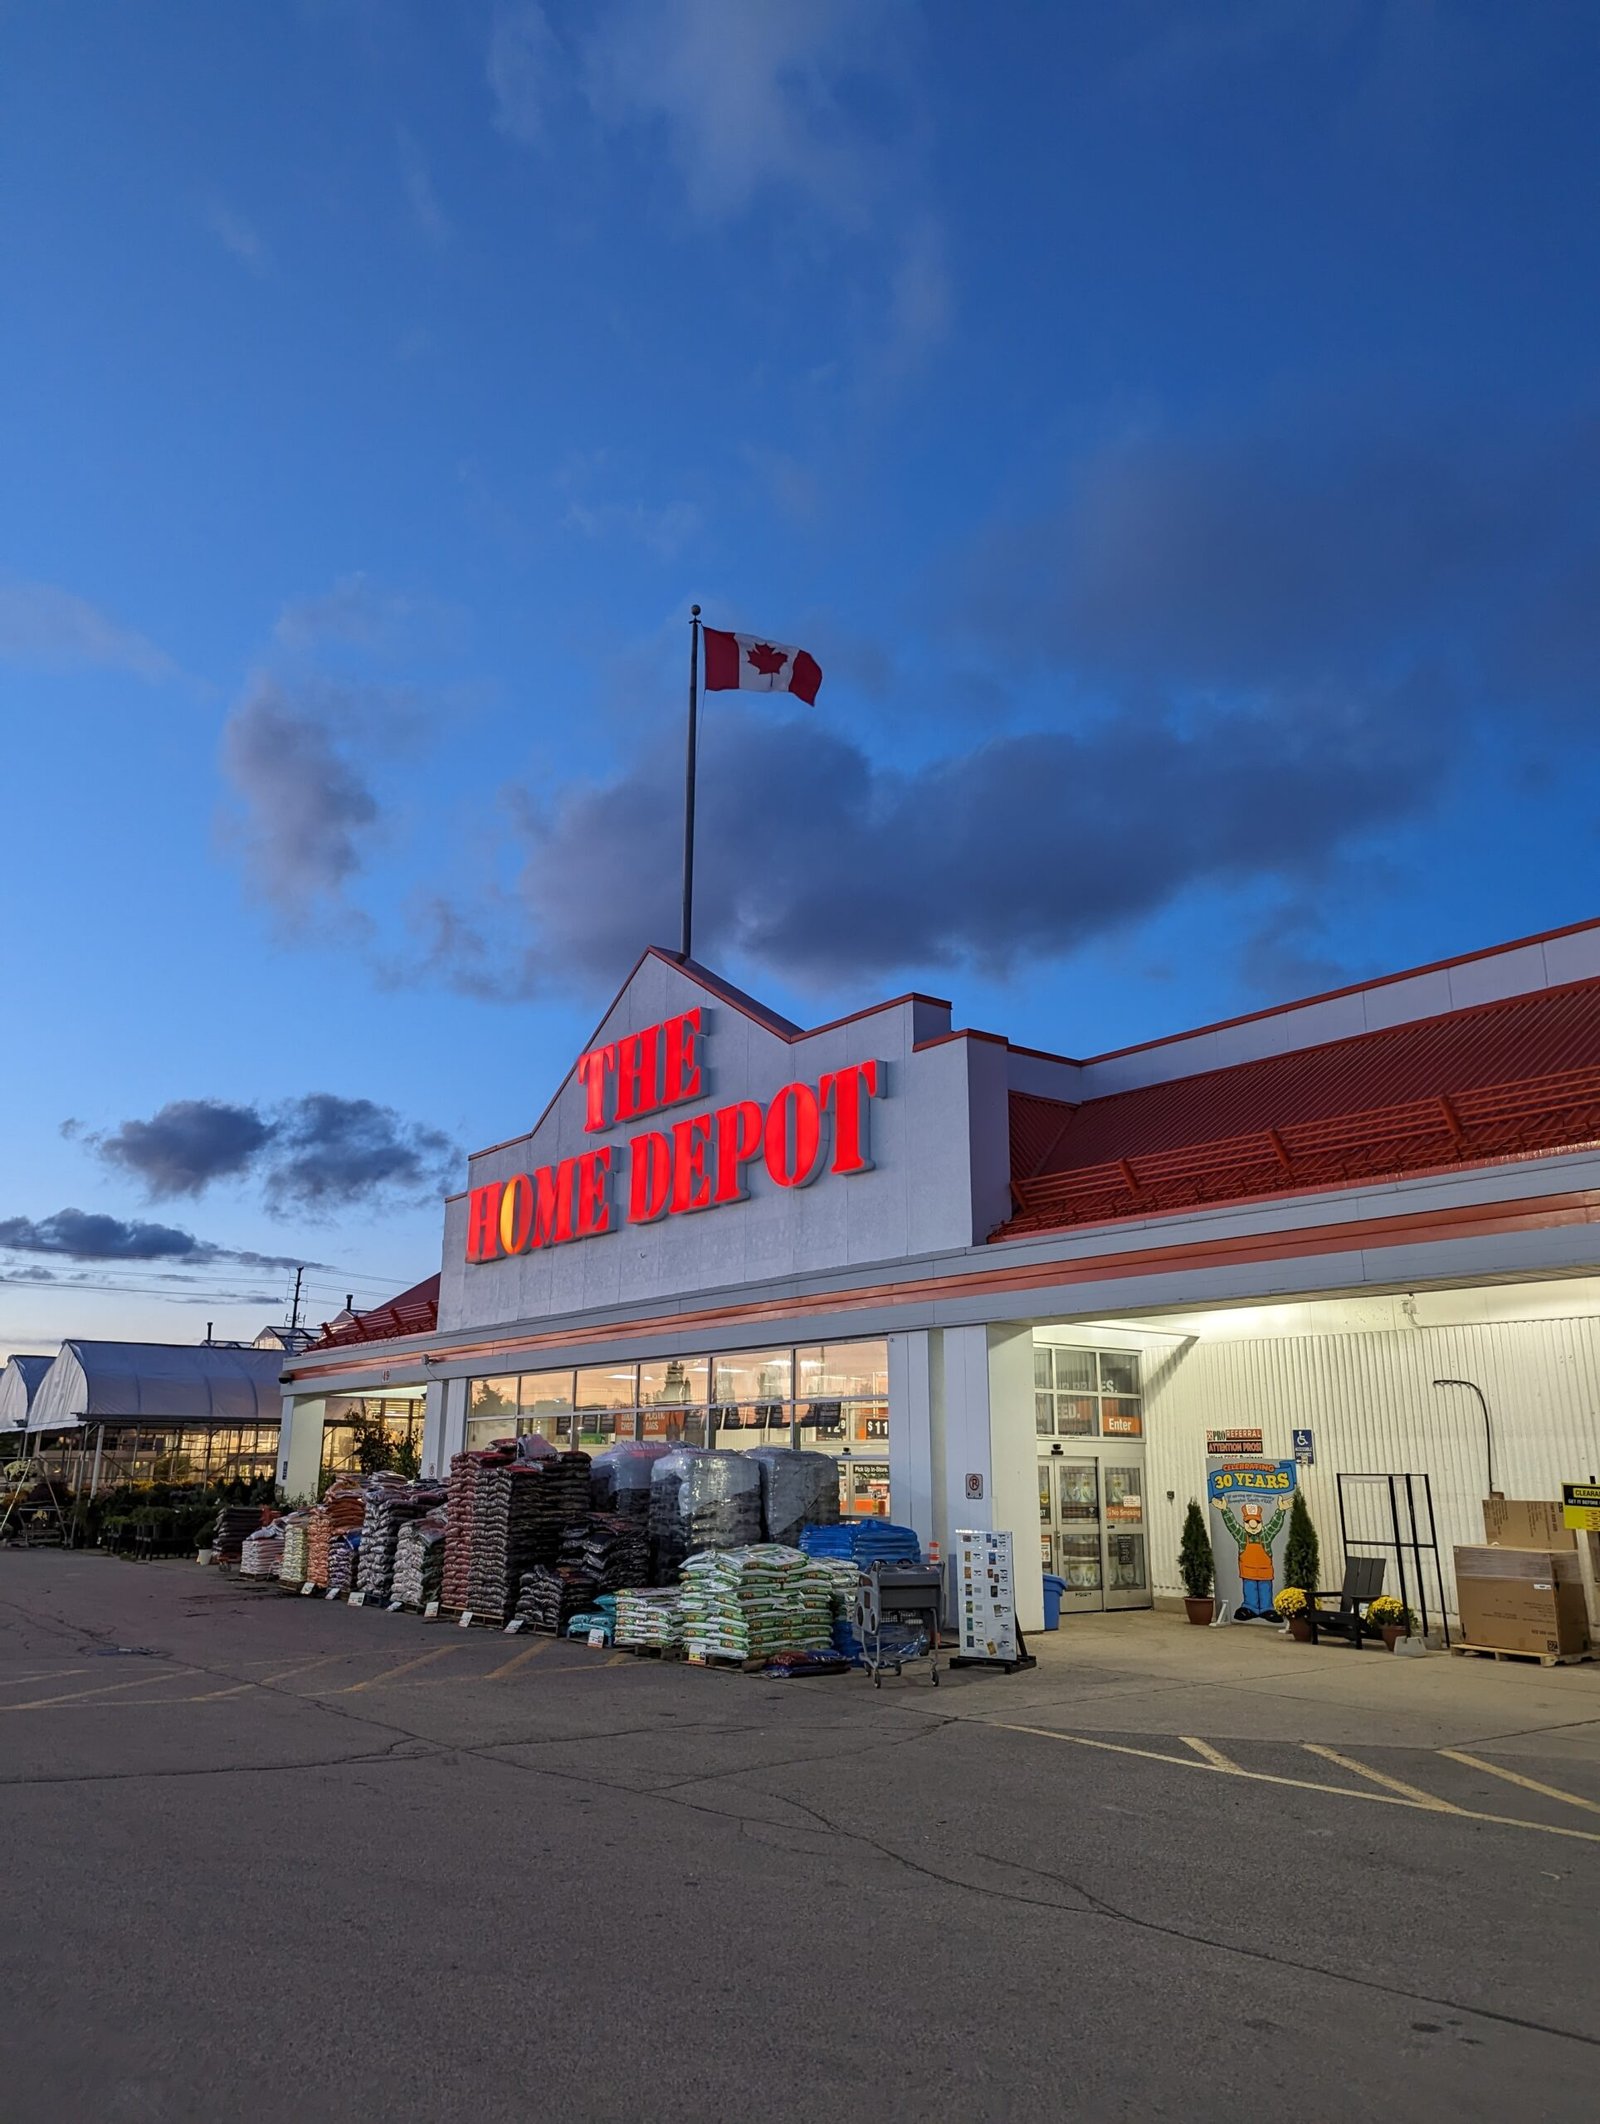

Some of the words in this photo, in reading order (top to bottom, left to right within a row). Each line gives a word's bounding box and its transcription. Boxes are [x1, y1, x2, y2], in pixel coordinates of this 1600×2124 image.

[579, 1006, 702, 1134] THE
[465, 1146, 613, 1264] HOME
[627, 1059, 879, 1224] DEPOT
[1108, 1418, 1132, 1431] Enter
[1213, 1430, 1226, 1441] PRO
[1226, 1429, 1261, 1438] REFERRAL
[1208, 1442, 1241, 1452] ATTENTION
[1223, 1463, 1275, 1472] CELEBRATING
[1214, 1474, 1232, 1489] 30
[1235, 1472, 1290, 1489] YEARS
[1120, 1509, 1141, 1518] Smoking
